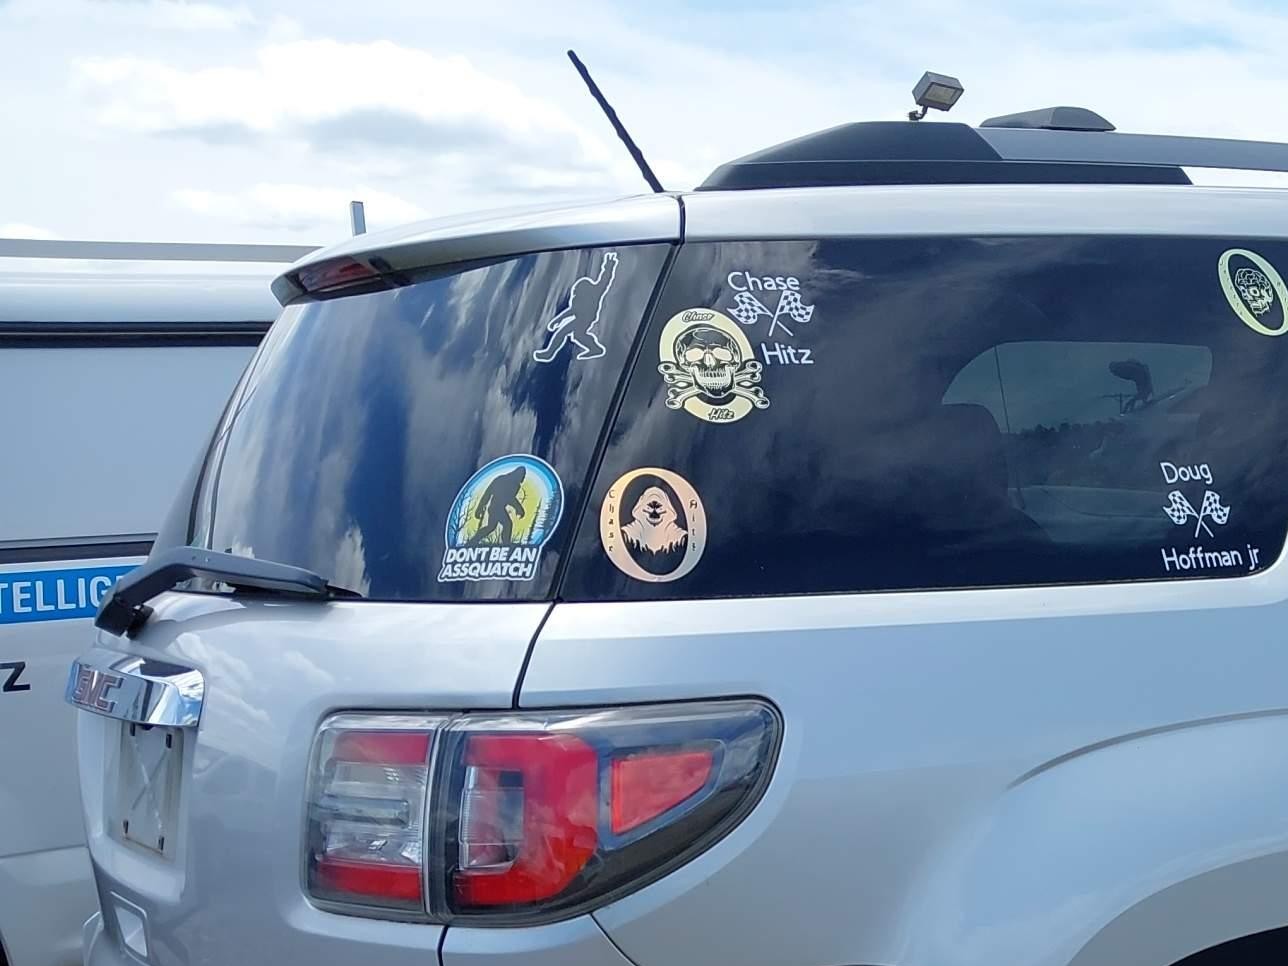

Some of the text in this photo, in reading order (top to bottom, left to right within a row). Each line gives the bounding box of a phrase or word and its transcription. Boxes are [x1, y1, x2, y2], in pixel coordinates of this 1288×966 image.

[727, 271, 801, 291] Chase
[682, 311, 715, 323] Chase
[760, 342, 815, 366] Hitz
[708, 408, 735, 420] Hitz
[1160, 462, 1213, 485] Doug
[446, 547, 537, 563] DON'T BE AN
[1161, 543, 1260, 571] Hoffman jr
[441, 562, 533, 578] ASSQUATCH
[0, 575, 122, 614] TELLIG
[72, 663, 124, 713] GMC
